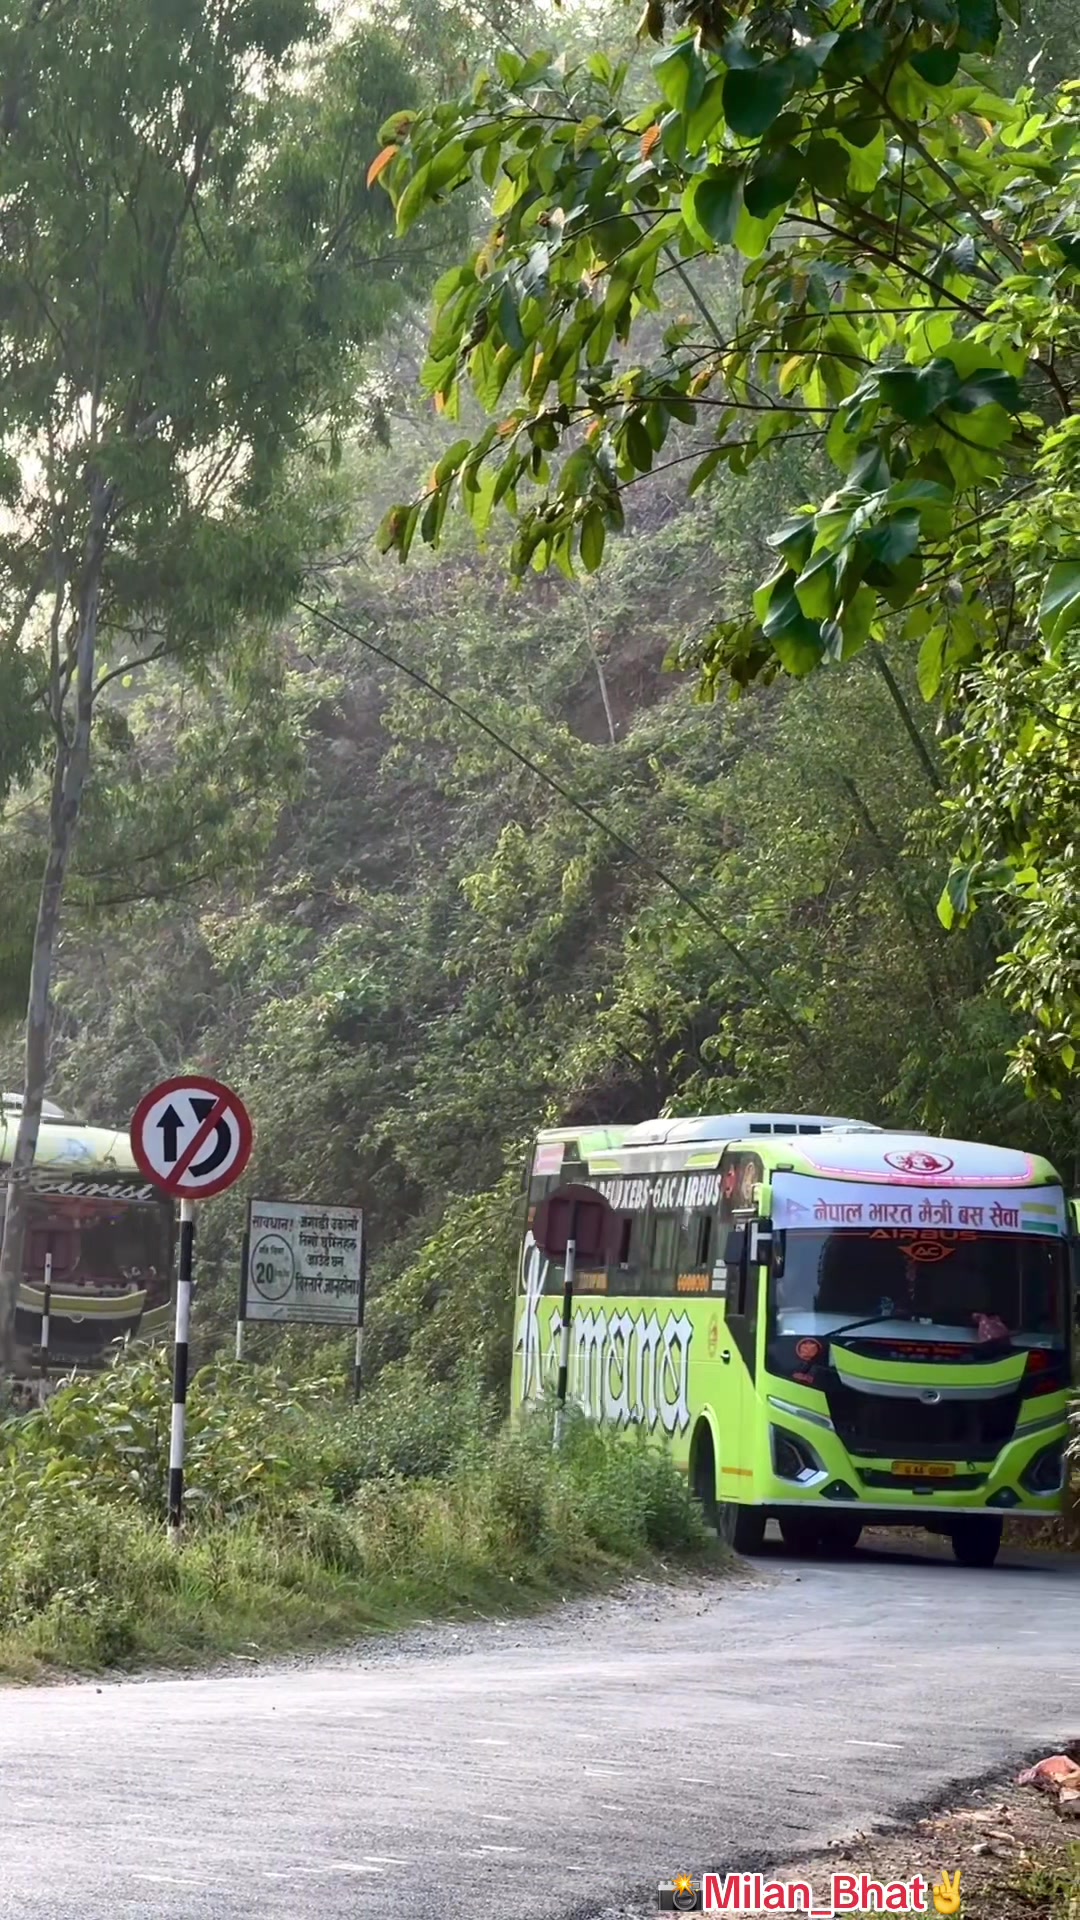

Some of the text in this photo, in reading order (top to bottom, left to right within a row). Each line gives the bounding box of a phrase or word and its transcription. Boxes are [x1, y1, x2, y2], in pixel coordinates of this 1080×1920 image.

[32, 1175, 154, 1200] ourist
[675, 1174, 722, 1207] AIRBUS
[813, 1197, 1019, 1228] नेपाल भारत मैत्री बस सेवा
[868, 1228, 978, 1240] AIRBUS
[914, 1247, 940, 1256] AC
[256, 1262, 274, 1284] 20
